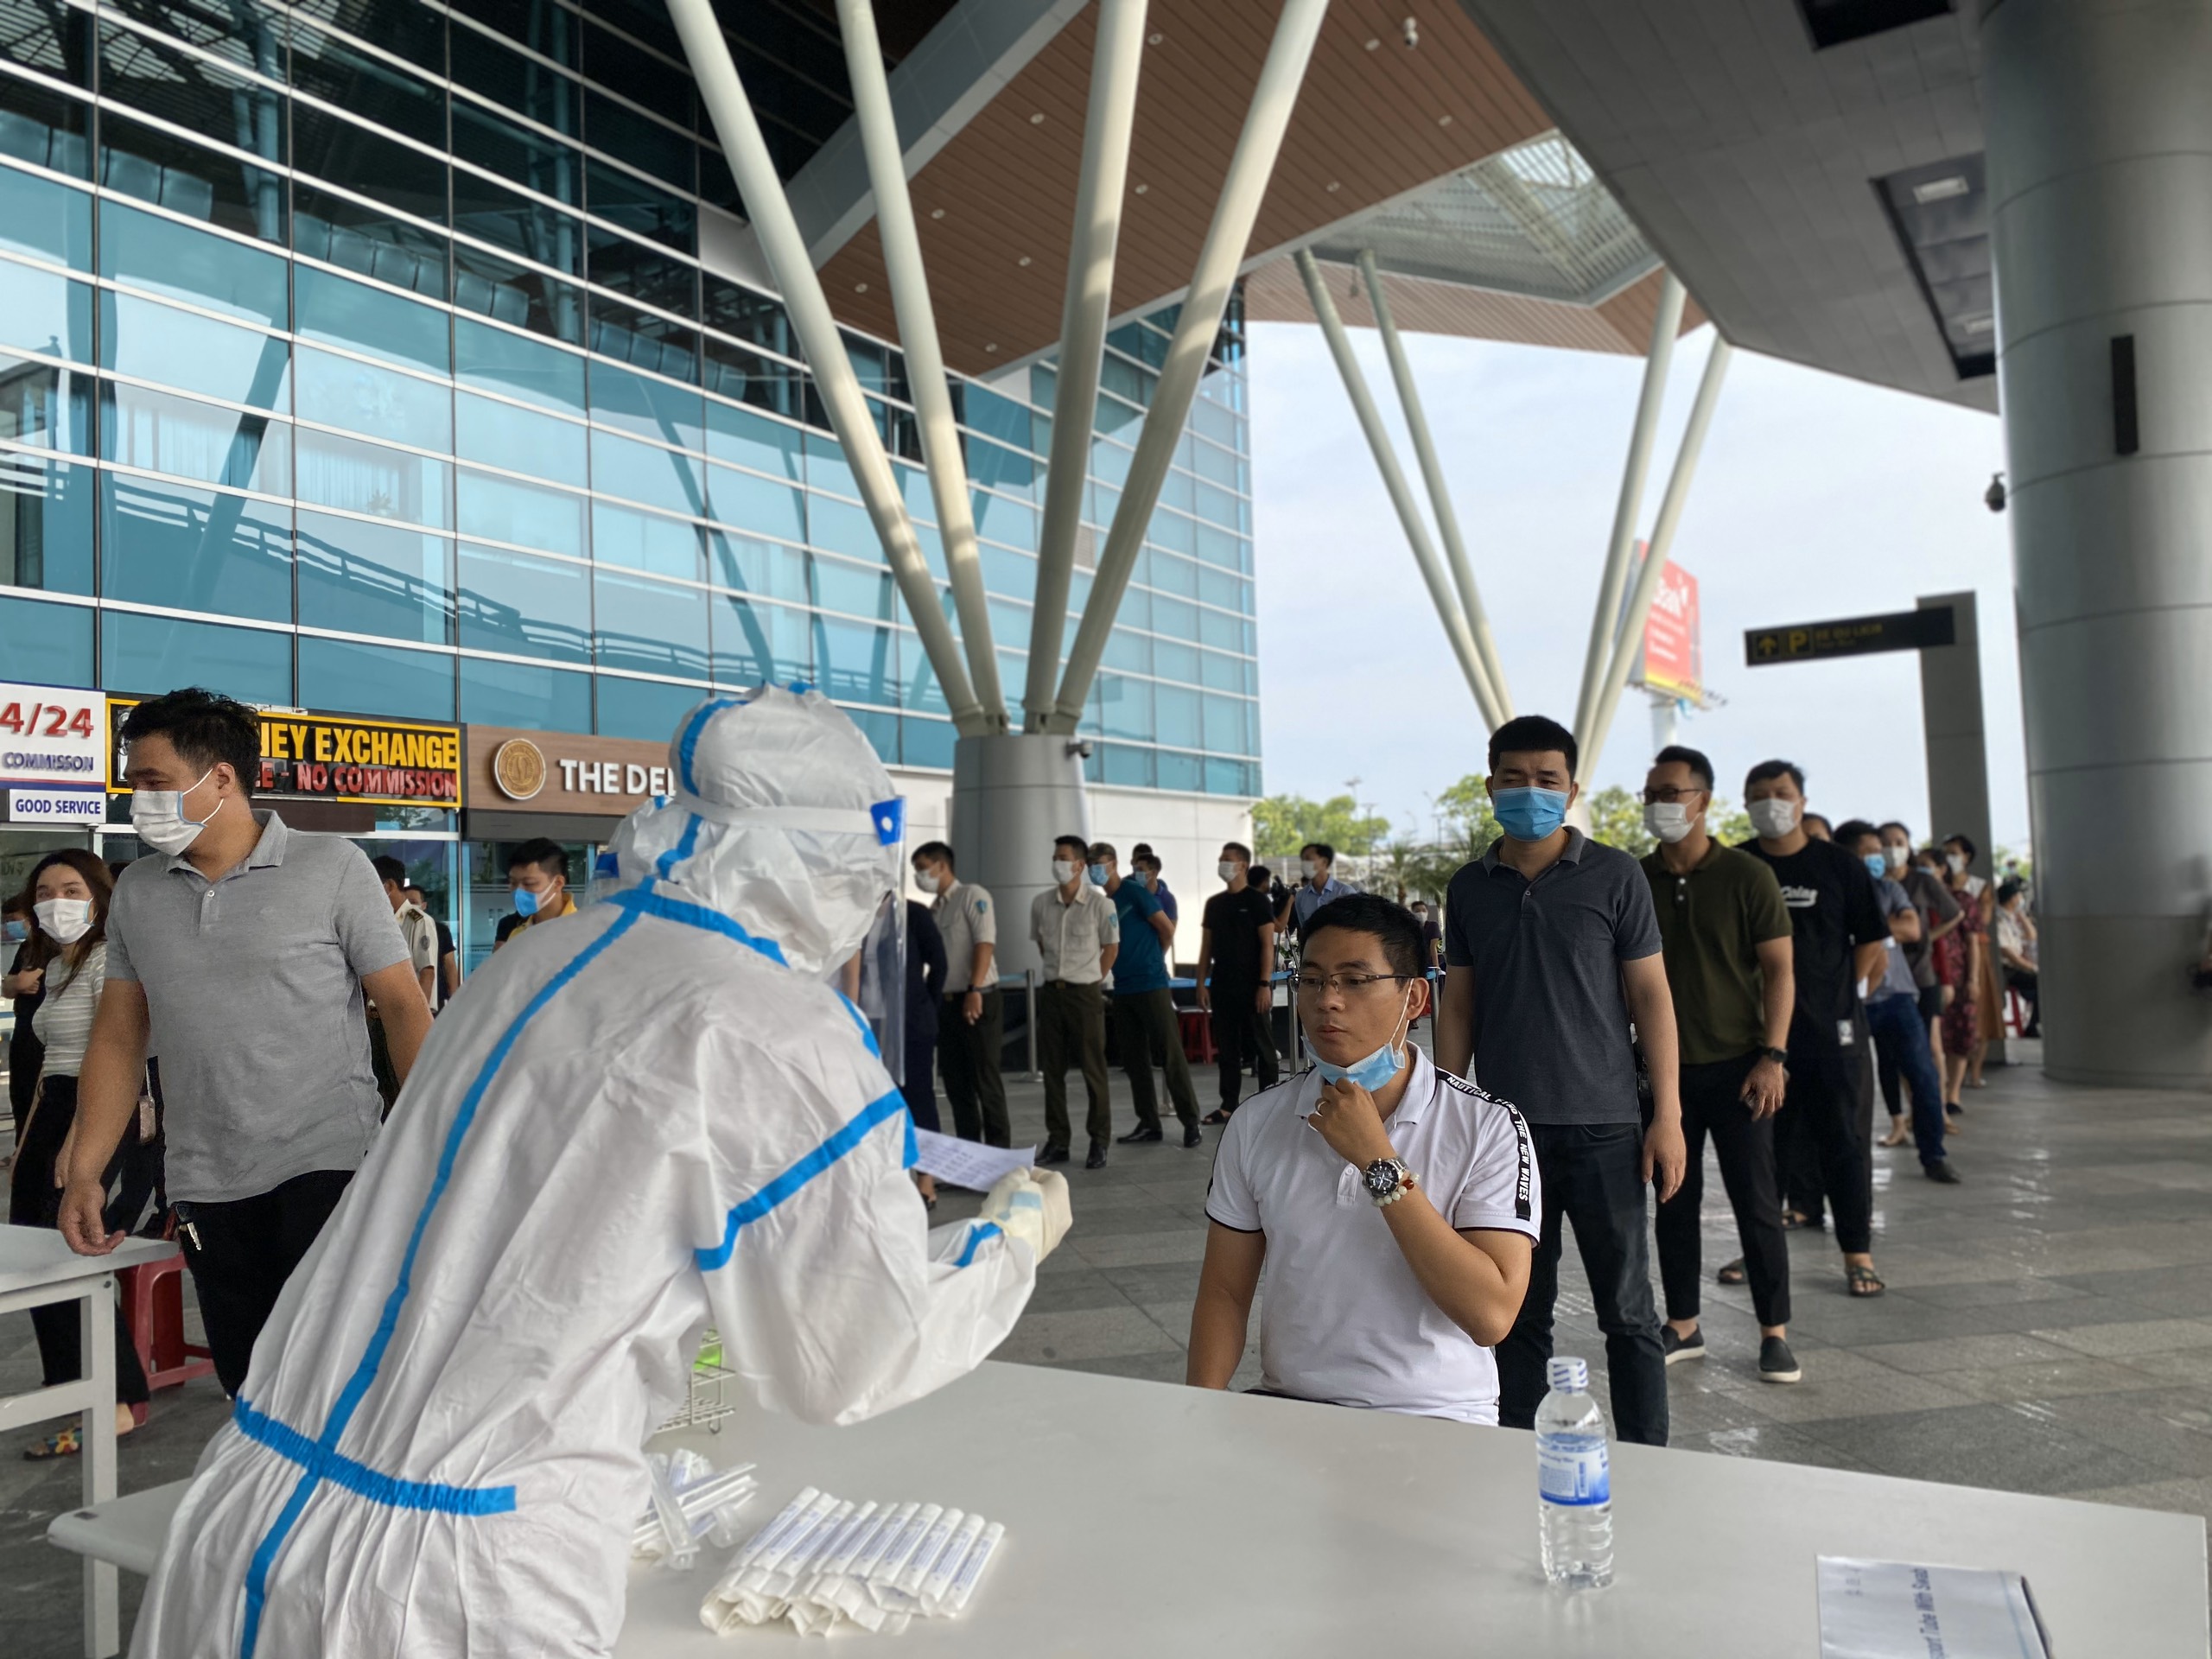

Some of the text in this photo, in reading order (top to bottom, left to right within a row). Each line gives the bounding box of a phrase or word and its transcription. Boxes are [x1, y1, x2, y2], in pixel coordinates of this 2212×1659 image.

[0, 702, 94, 737] 4/24
[259, 721, 308, 760] NEY
[315, 727, 456, 769] EXCHANGE
[296, 762, 327, 791] NO
[334, 765, 456, 797] COMMISSION
[559, 759, 620, 793] THE
[16, 798, 101, 815] GOOD SERVICE
[1446, 1076, 1491, 1101] NAUTICAL
[1514, 1119, 1527, 1139] THE
[1519, 1143, 1529, 1165] NEW
[1518, 1167, 1530, 1202] WAVES
